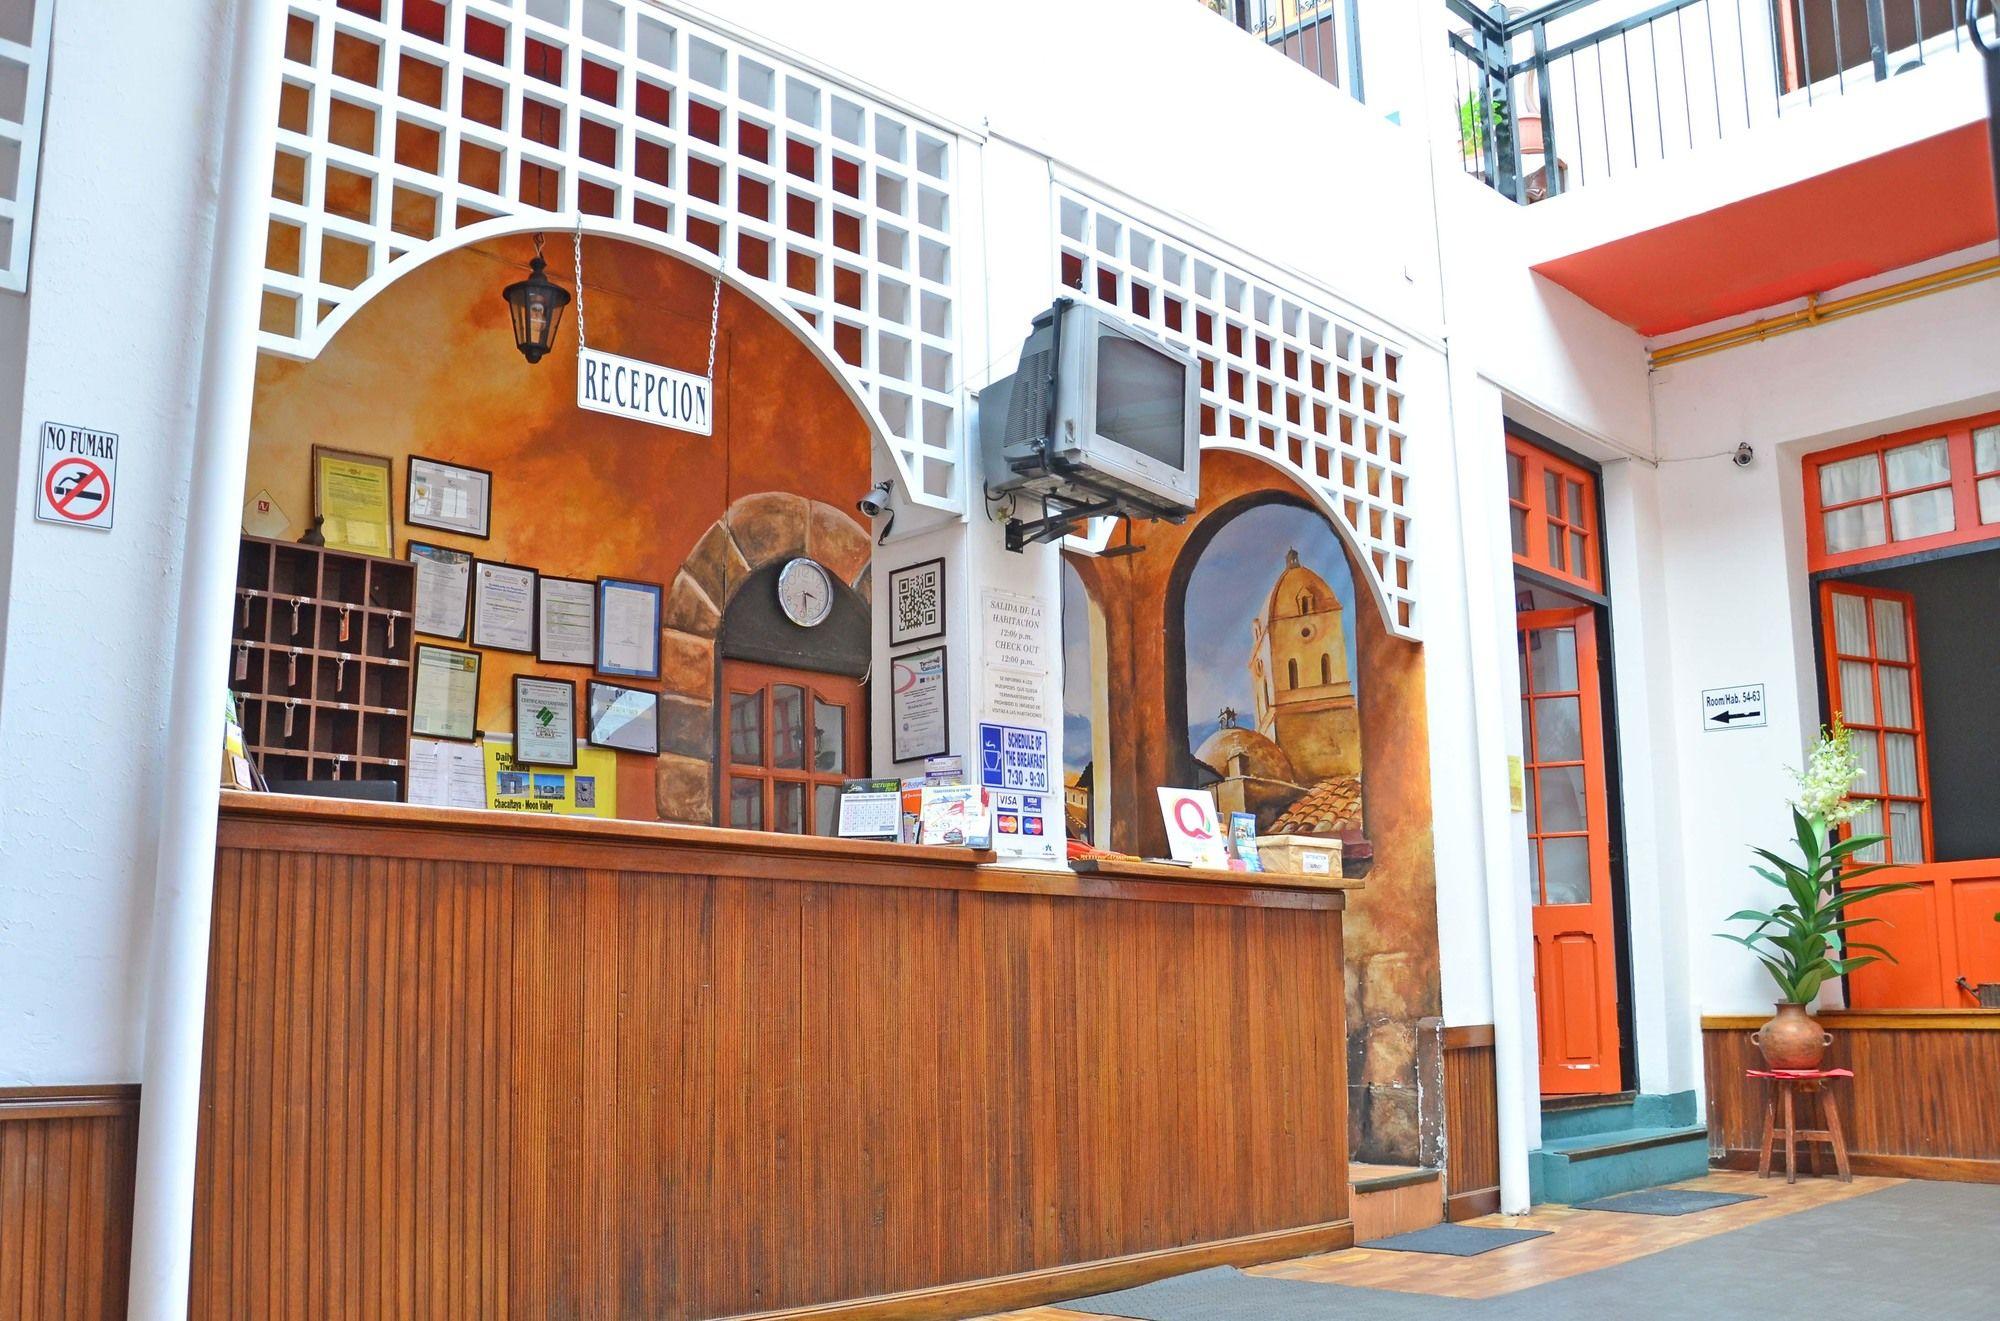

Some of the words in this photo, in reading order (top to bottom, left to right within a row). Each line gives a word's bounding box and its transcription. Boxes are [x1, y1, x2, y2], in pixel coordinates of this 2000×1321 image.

[585, 358, 706, 426] RECEPCION
[46, 426, 66, 451] NO
[70, 430, 114, 460] FUMAR
[990, 600, 1018, 613] SALIDA
[1019, 605, 1030, 615] DE
[1031, 607, 1041, 617] LA
[995, 640, 1022, 652] CHECK
[1022, 644, 1040, 654] OUT
[1001, 654, 1019, 664] 12:00
[1742, 690, 1761, 703] 54-63
[1007, 732, 1035, 750] SCHEDULE
[1035, 735, 1042, 751] OF
[495, 752, 512, 764] Daily
[1005, 750, 1016, 767] THE
[1017, 751, 1046, 769] BREAKFAST
[1007, 769, 1024, 785] 7:30
[1029, 771, 1045, 788] 9:30
[494, 798, 522, 811] Chacaltaya
[525, 799, 538, 810] Moon
[539, 799, 554, 812] Valley
[1000, 795, 1017, 805] VISA
